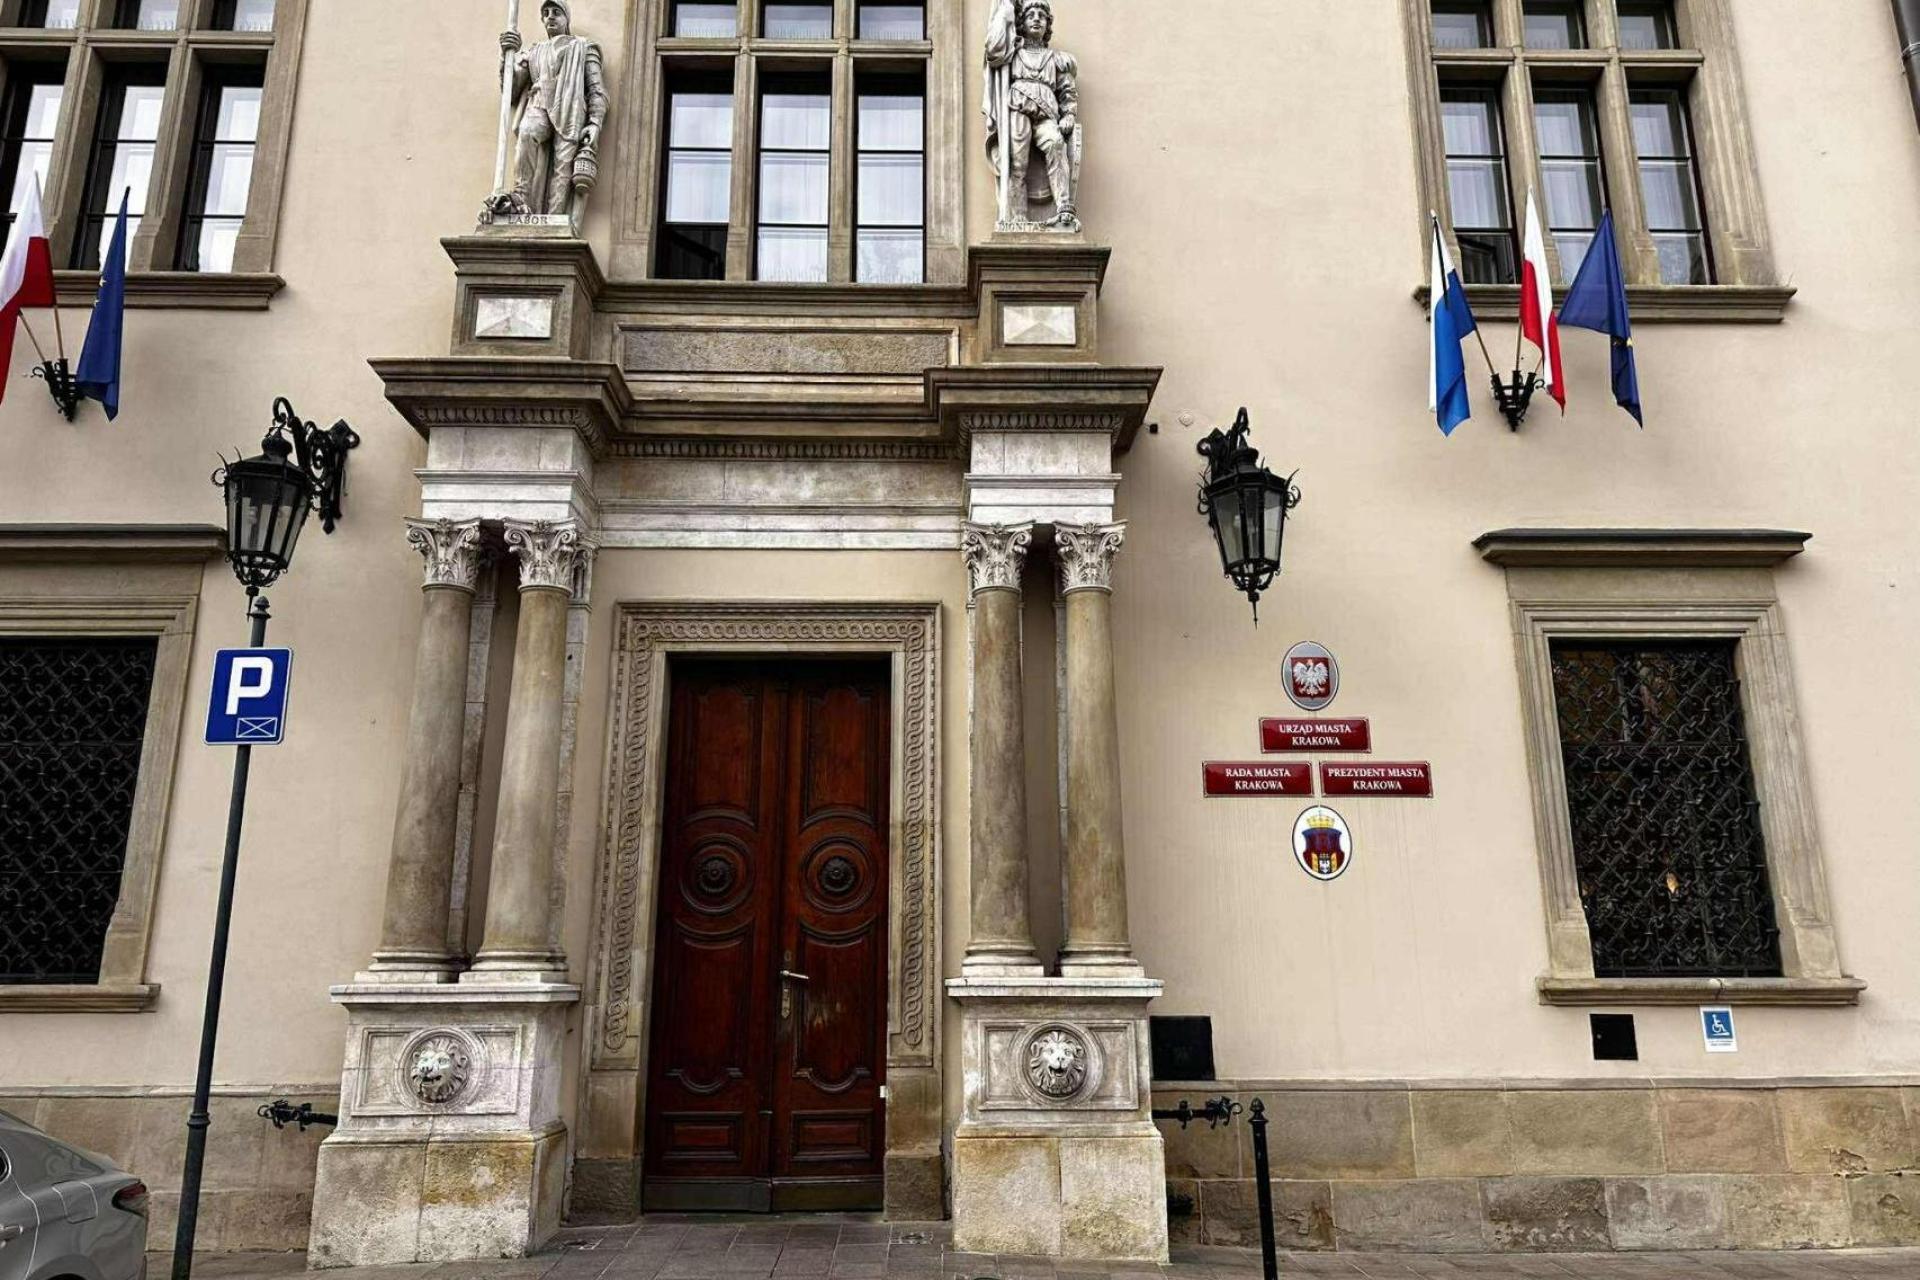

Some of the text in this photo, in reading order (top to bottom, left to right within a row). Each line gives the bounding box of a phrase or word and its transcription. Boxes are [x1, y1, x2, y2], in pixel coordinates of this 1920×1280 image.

[509, 215, 548, 225] LABOR
[225, 656, 274, 715] P
[1279, 724, 1352, 734] URZĄD MIASTA
[1292, 737, 1340, 746] KRAKOWA
[1225, 768, 1291, 777] RADA MIASTA
[1328, 768, 1424, 777] PREZYDENT MIASTA
[1235, 781, 1284, 790] KRAKOWA
[1353, 780, 1402, 790] KRAKOWA
